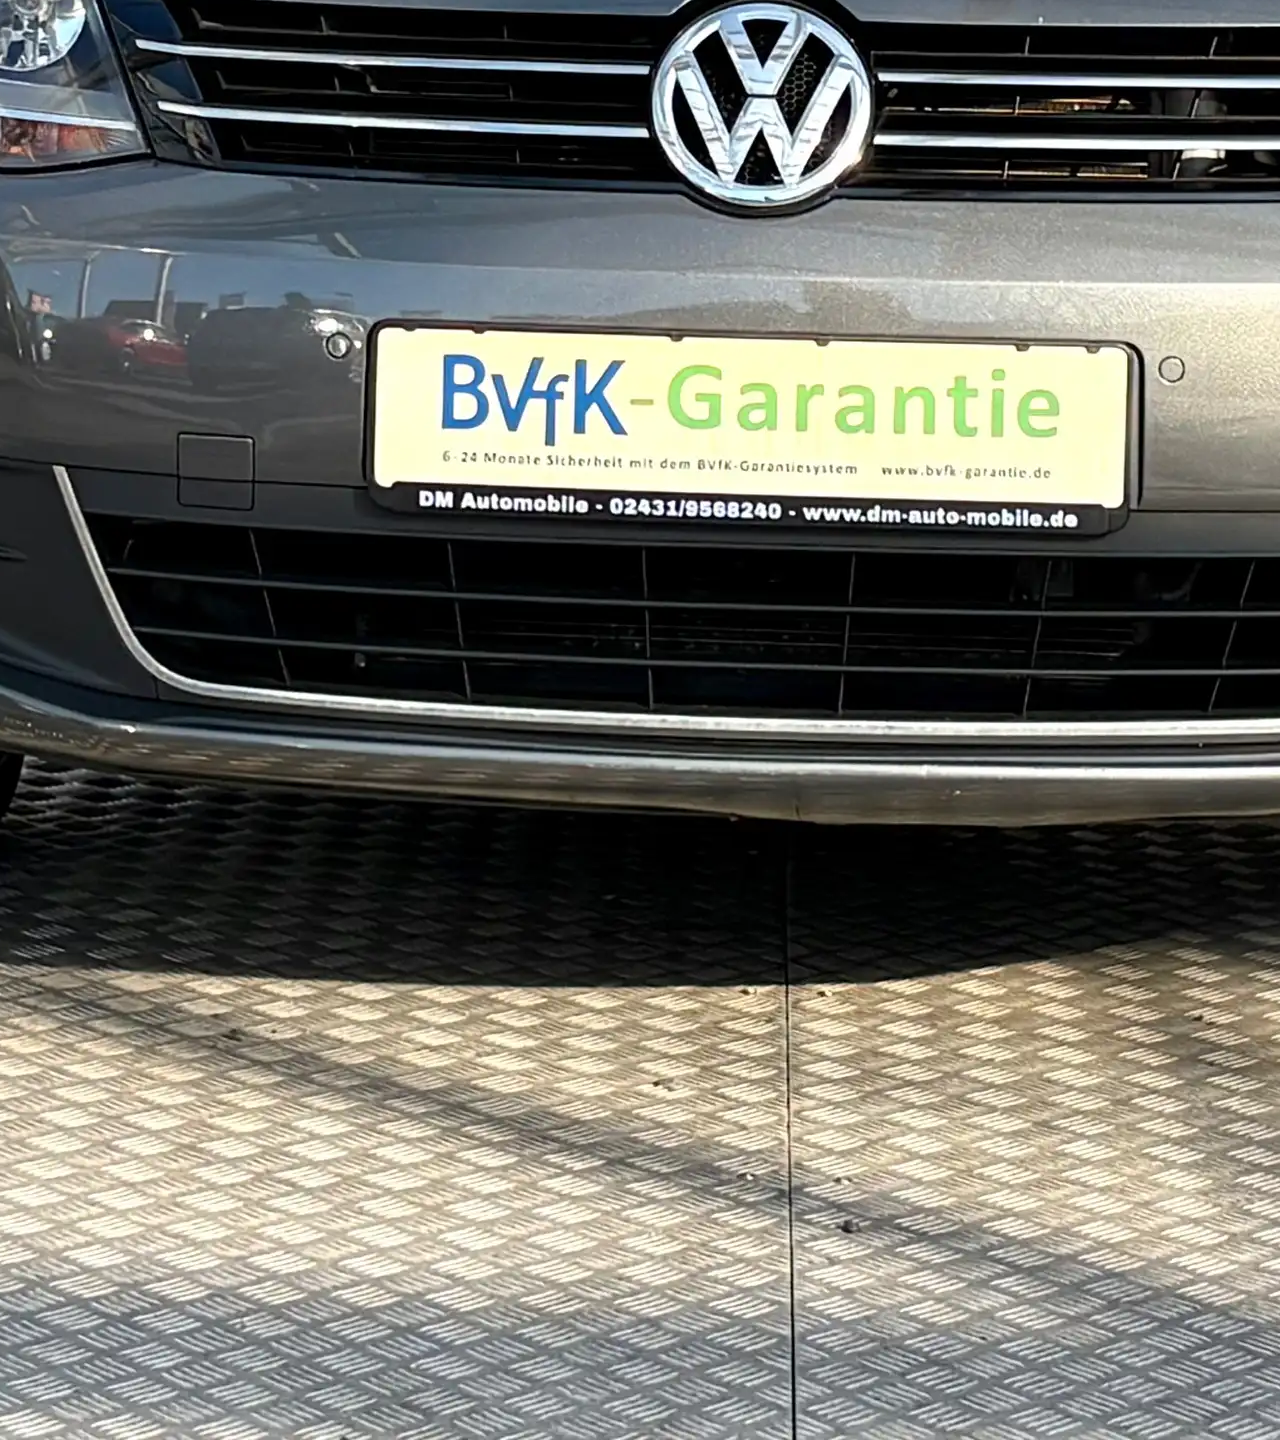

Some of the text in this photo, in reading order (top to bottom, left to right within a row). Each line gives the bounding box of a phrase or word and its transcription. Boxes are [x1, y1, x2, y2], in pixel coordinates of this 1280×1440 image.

[629, 458, 654, 469] mit
[659, 458, 691, 470] dem
[419, 490, 455, 508] DM
[461, 491, 589, 513] Automobile
[609, 497, 782, 520] 02431/9568240
[802, 504, 1079, 528] www.dm-auto-mobile.de
